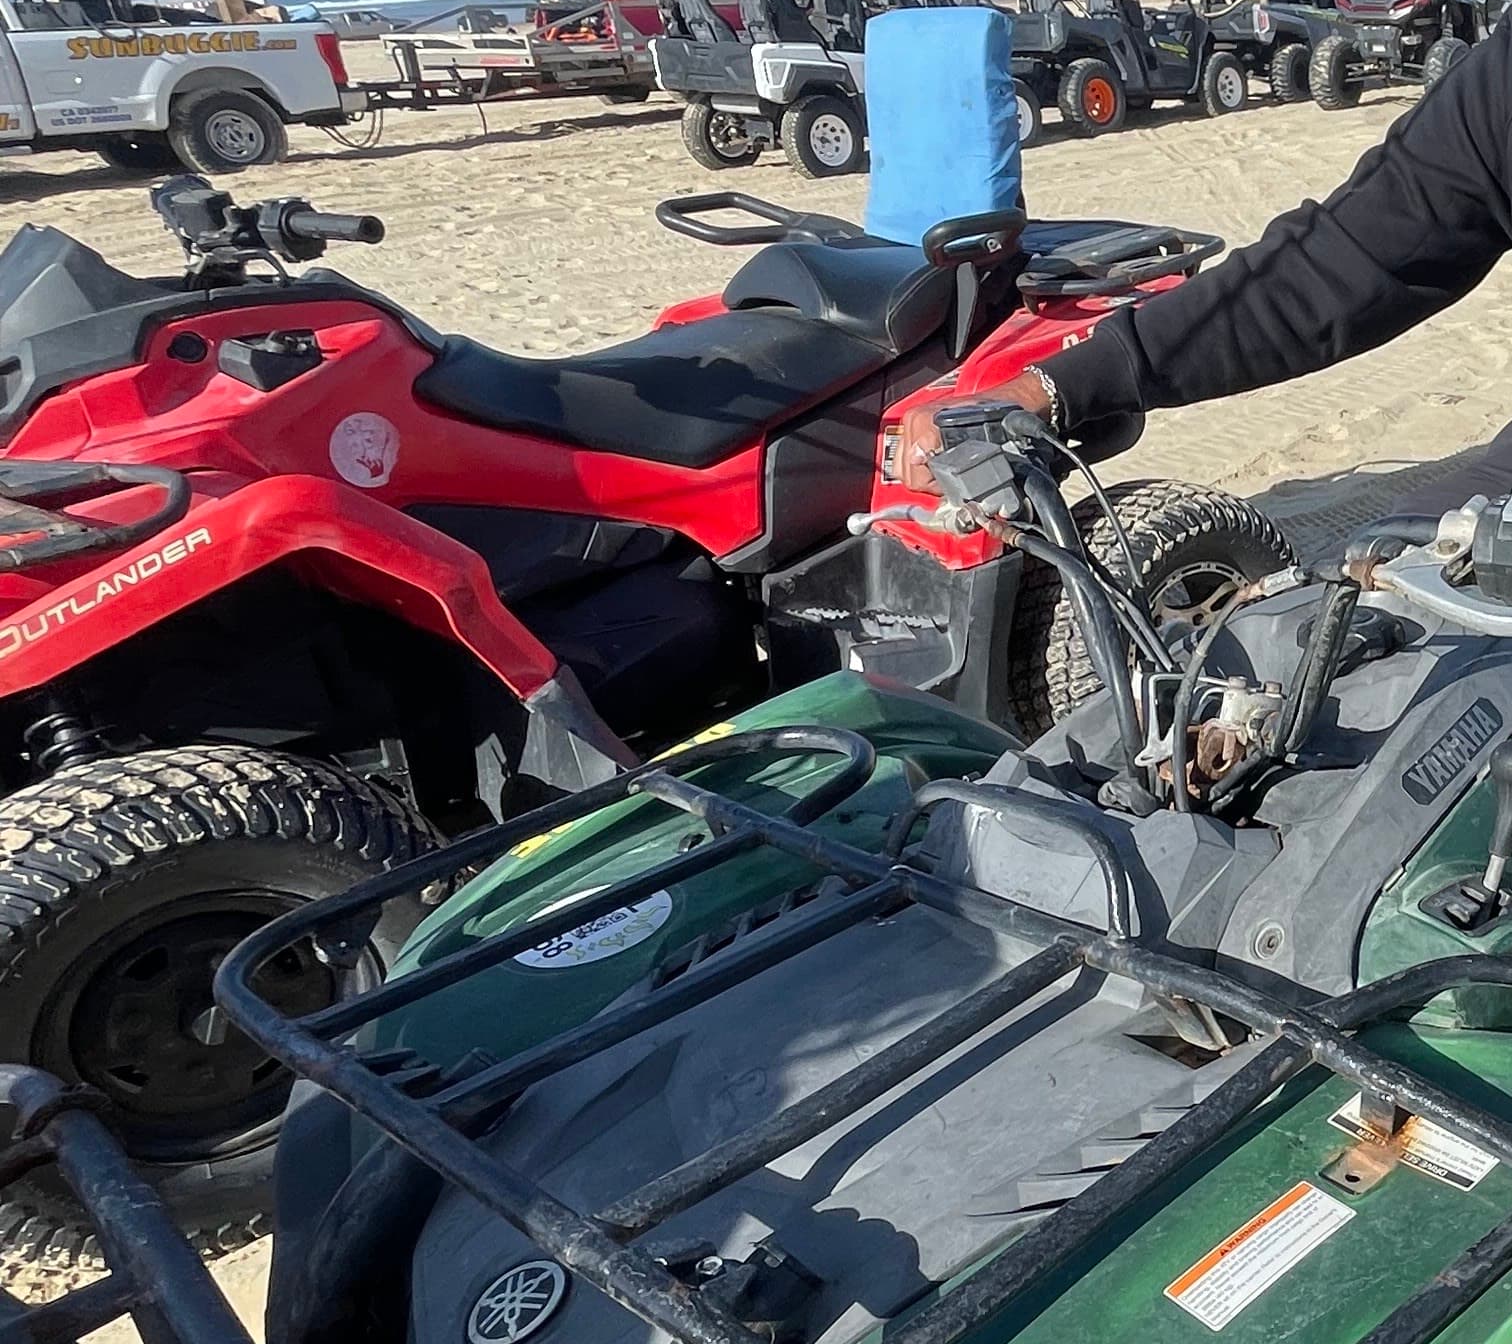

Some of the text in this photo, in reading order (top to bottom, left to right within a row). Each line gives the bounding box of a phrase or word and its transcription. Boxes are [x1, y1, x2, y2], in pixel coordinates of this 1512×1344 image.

[0, 527, 213, 657] OUTLANDER
[1407, 703, 1499, 795] YAMAHA
[1227, 1217, 1268, 1249] WARNING
